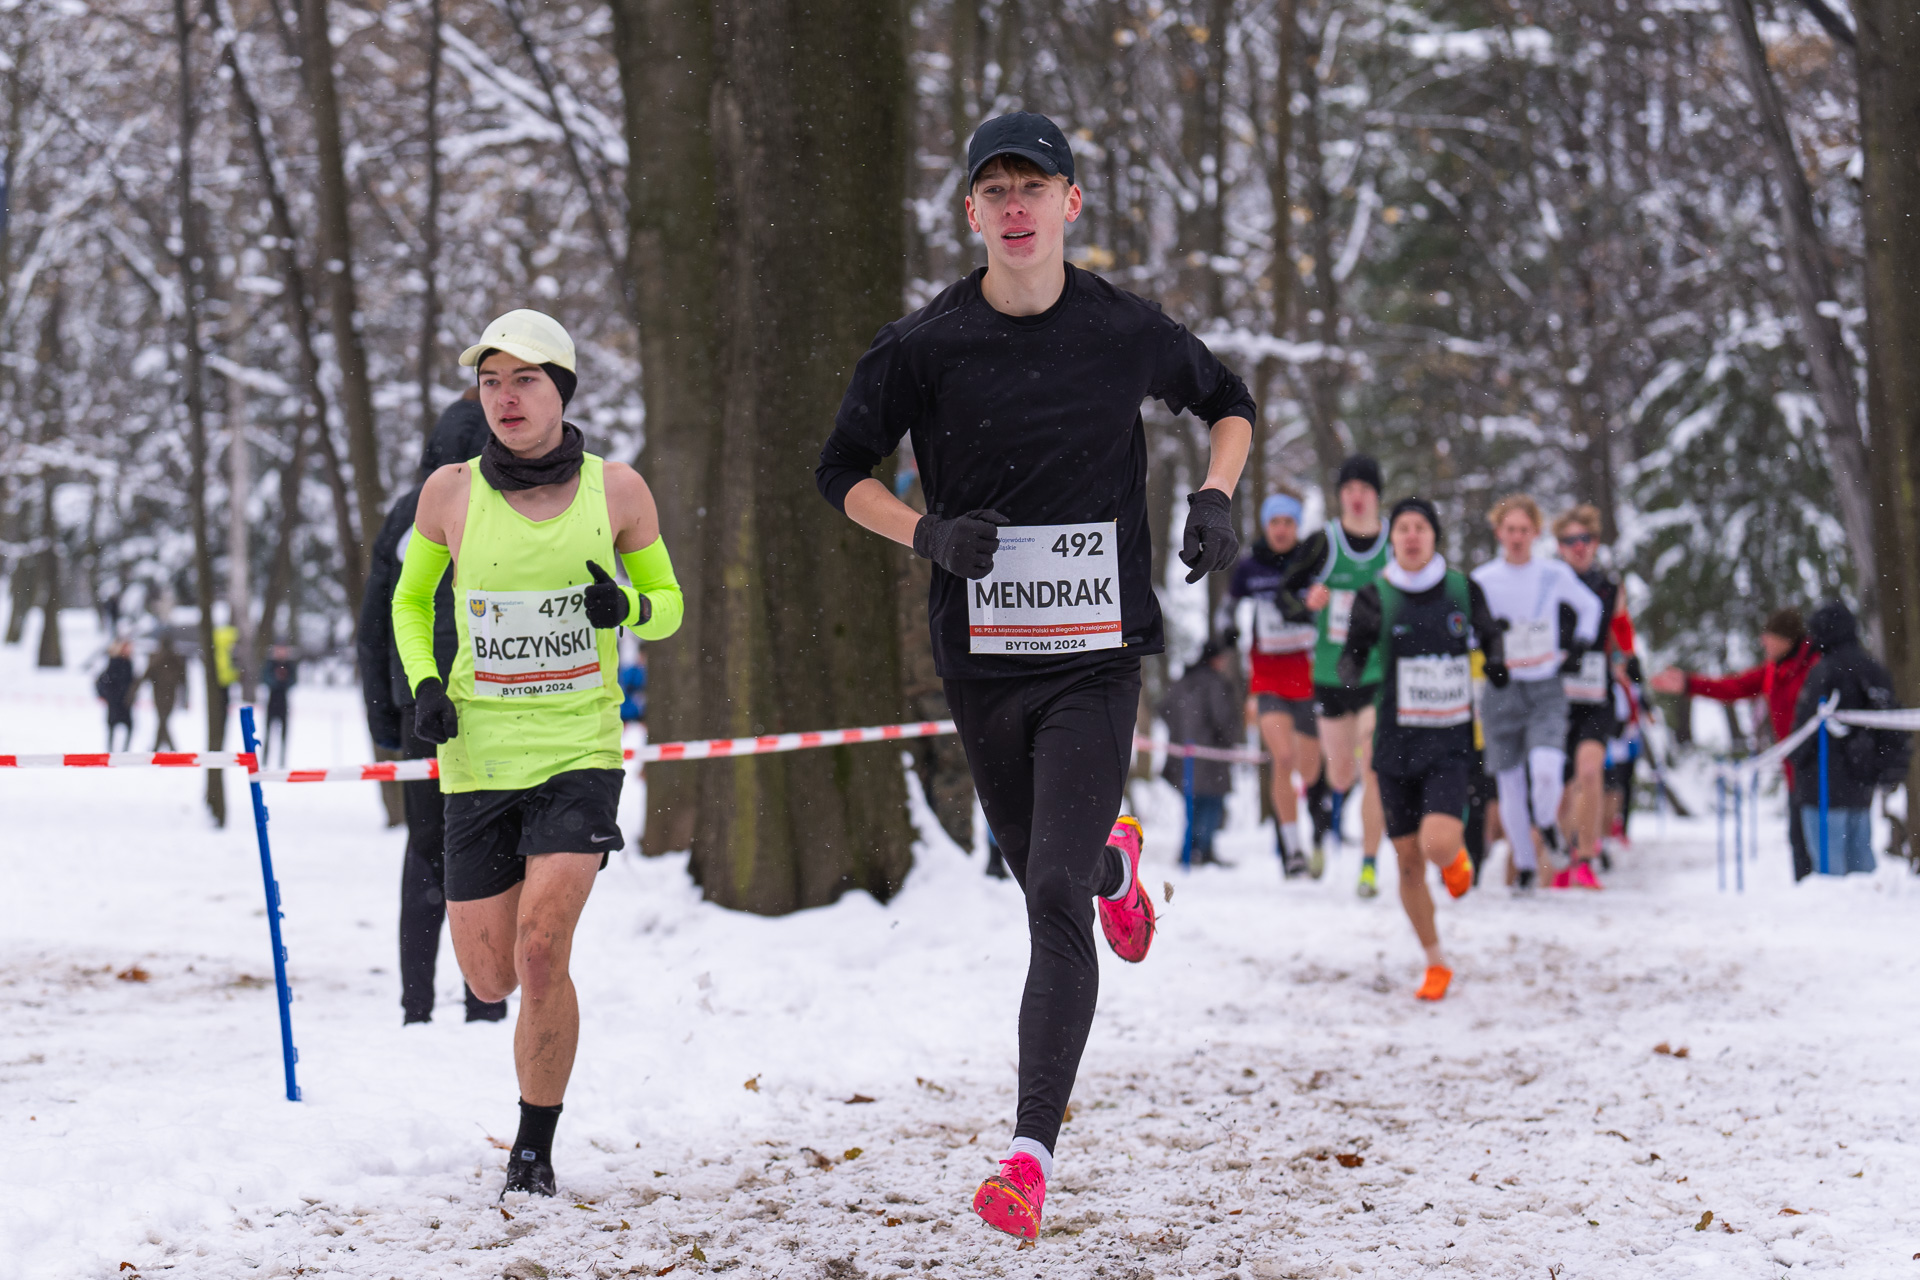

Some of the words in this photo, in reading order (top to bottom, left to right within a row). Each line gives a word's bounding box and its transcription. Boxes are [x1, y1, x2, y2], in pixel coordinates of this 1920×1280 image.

[1052, 532, 1104, 558] 492
[538, 593, 584, 618] 479
[975, 578, 1113, 608] MENDRAK
[1080, 624, 1118, 632] Przełajowych
[474, 628, 591, 660] BACZYŃSKI
[1005, 641, 1052, 651] BYTOM
[1054, 639, 1087, 650] 2024
[502, 685, 542, 696] BYTOM
[546, 682, 574, 693] 2024
